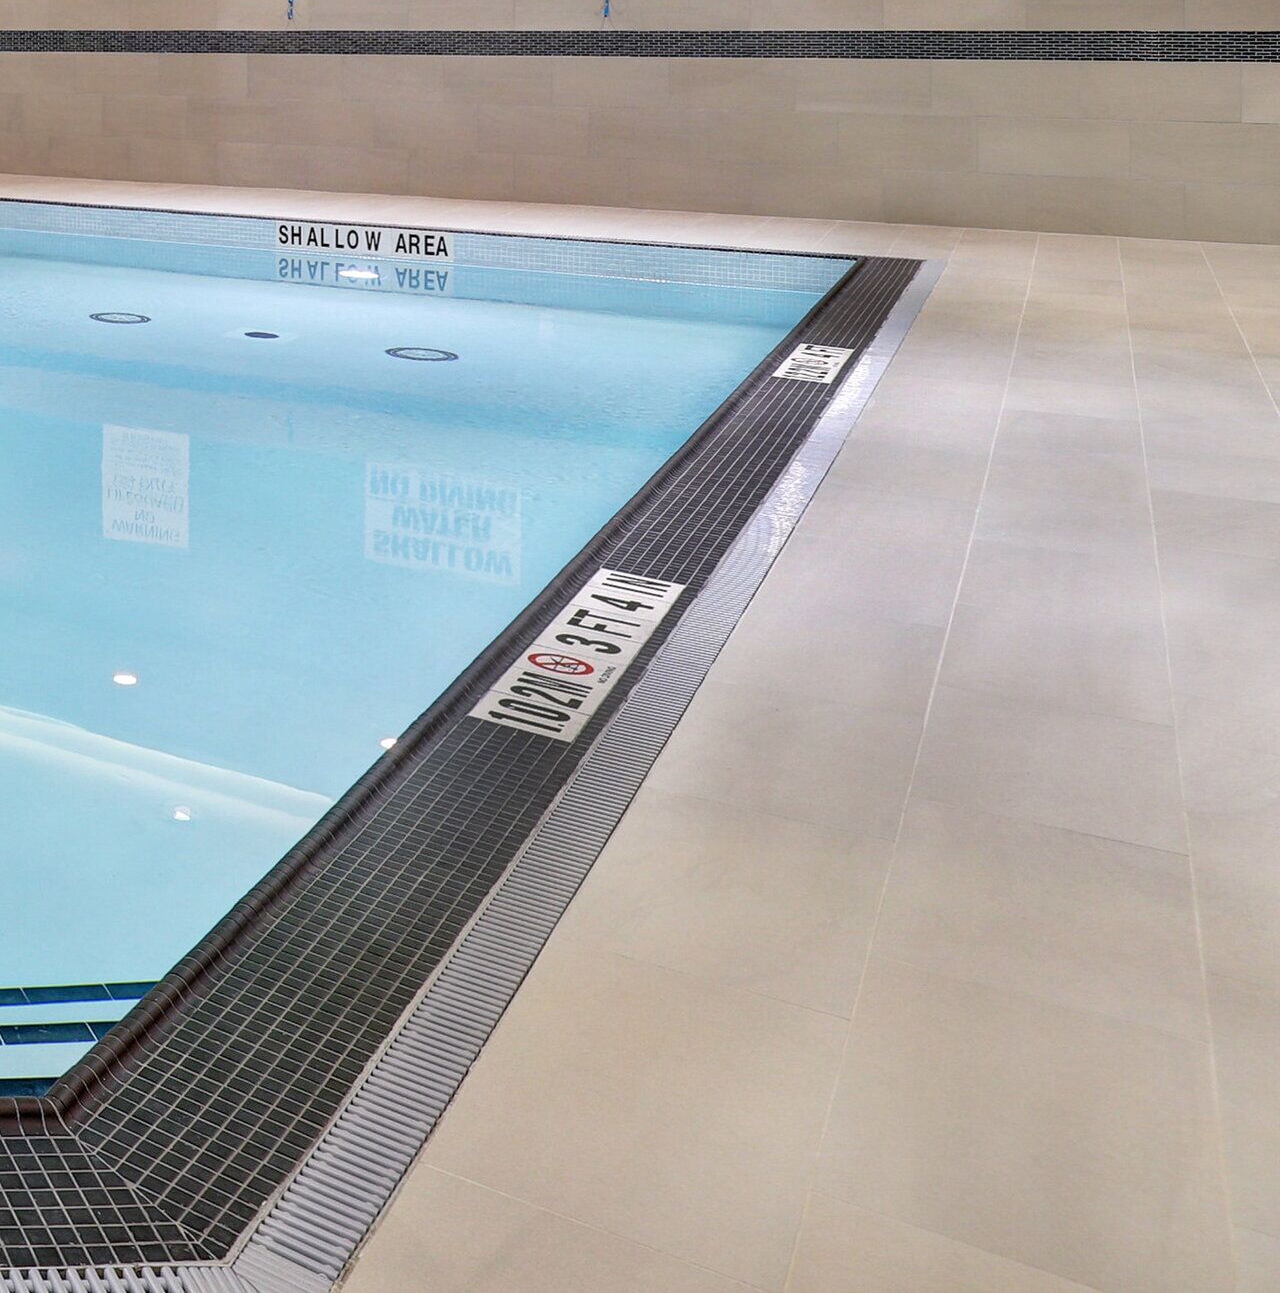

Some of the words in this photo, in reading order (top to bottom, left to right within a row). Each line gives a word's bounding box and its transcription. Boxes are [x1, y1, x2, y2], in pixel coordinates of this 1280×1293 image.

[279, 224, 381, 251] SHALLOW
[395, 234, 448, 256] AREA
[602, 573, 671, 598] IN
[591, 594, 653, 612] 4
[567, 610, 640, 638] FT
[555, 634, 622, 654] 3
[489, 671, 592, 733] 1.02M
